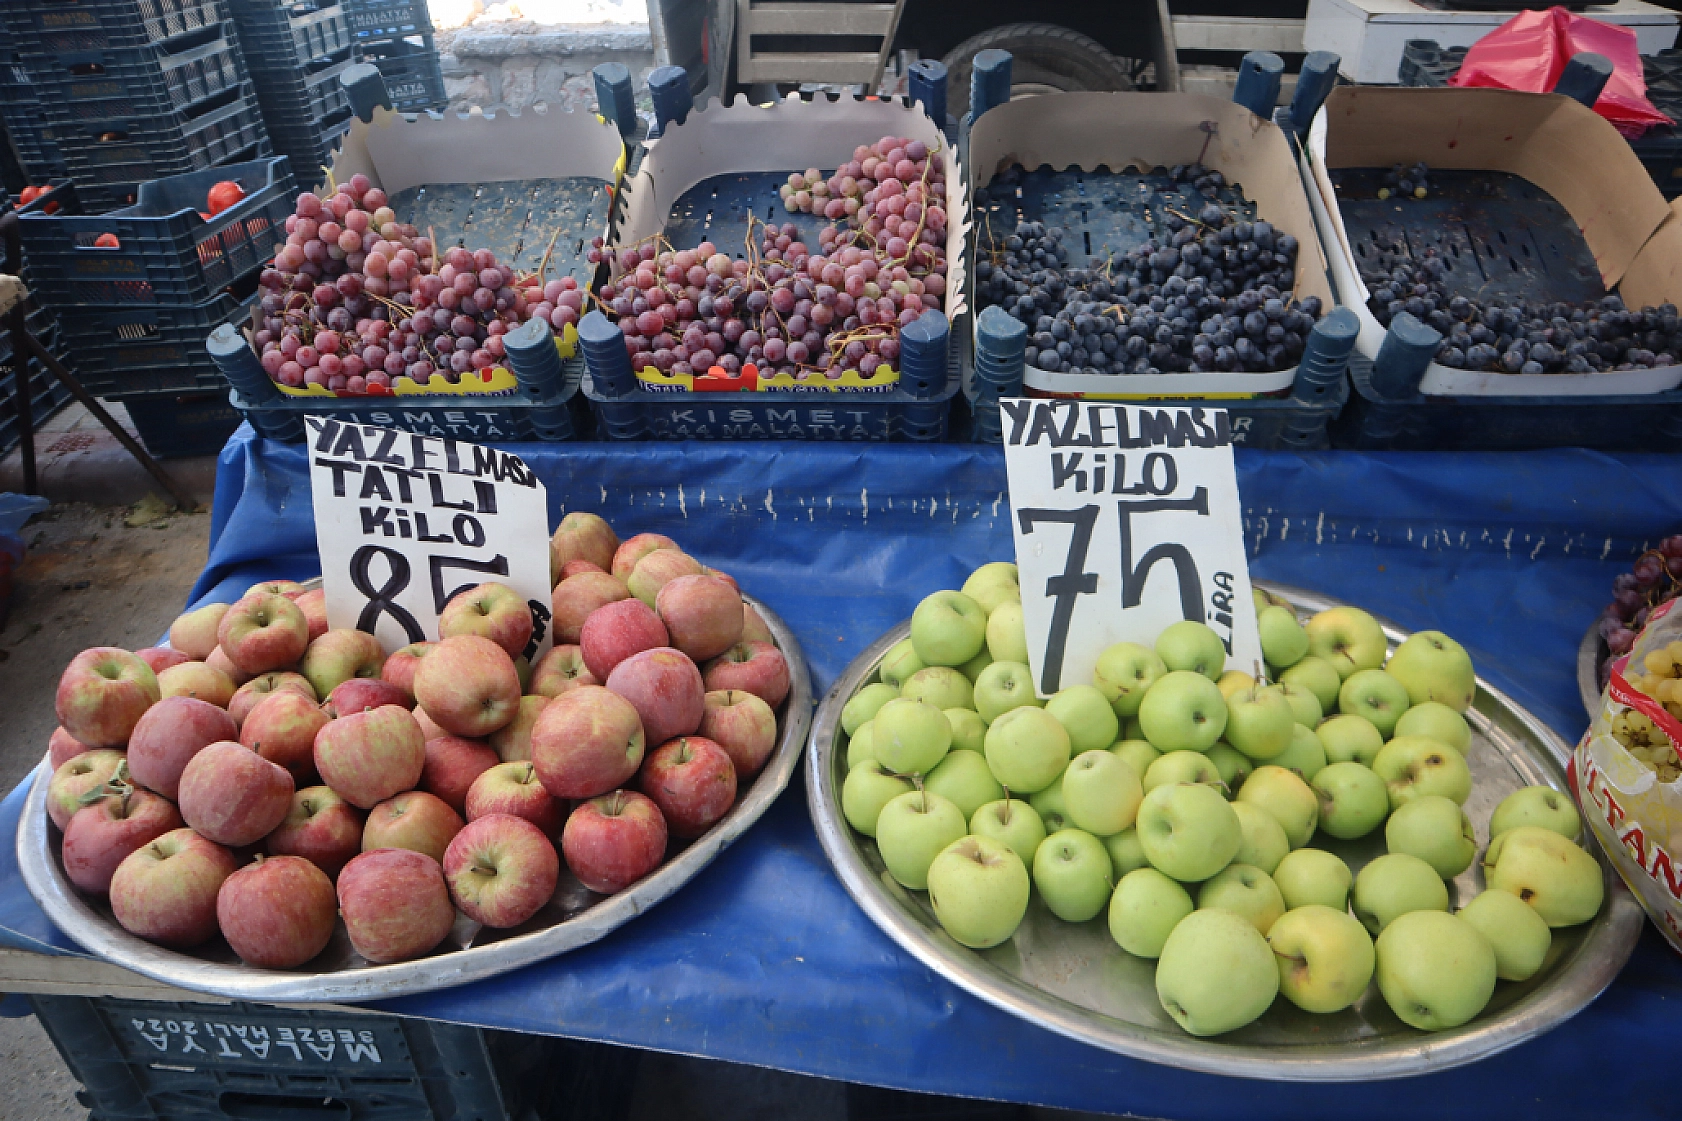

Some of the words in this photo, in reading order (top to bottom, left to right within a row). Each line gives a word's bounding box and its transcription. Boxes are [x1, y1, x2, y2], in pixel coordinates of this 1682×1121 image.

[671, 409, 870, 423] KISMET
[724, 423, 868, 436] MALATYA
[315, 457, 497, 515] TATLI
[1017, 485, 1210, 695] 75
[131, 1018, 199, 1035] 2024
[140, 1032, 382, 1063] MALATYA
